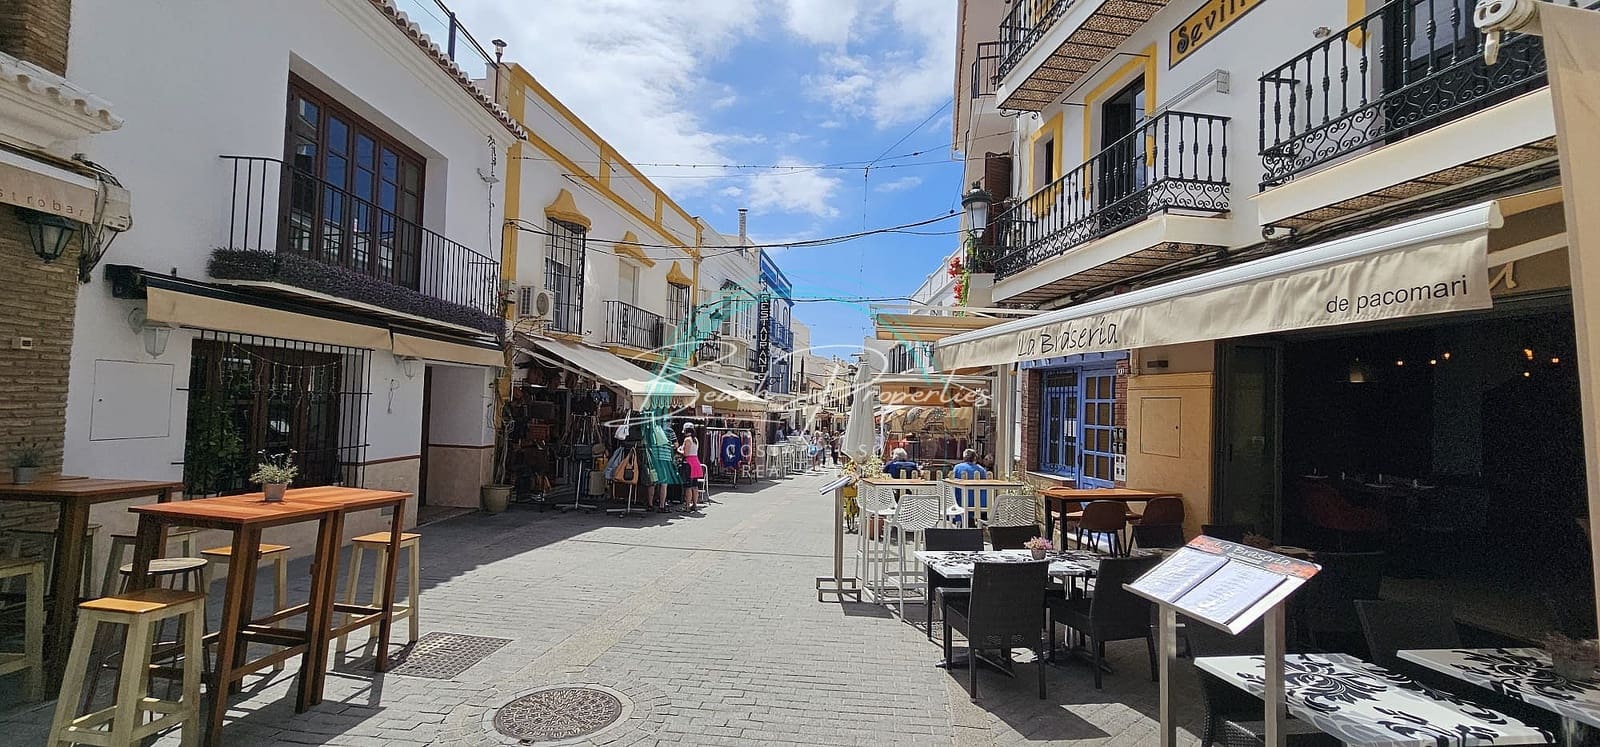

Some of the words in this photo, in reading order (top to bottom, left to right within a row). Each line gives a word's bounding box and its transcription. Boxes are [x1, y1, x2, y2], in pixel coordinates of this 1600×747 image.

[1177, 0, 1246, 54] Sevil
[1326, 295, 1349, 314] de
[1356, 274, 1467, 314] pacomari
[1017, 334, 1036, 357] La
